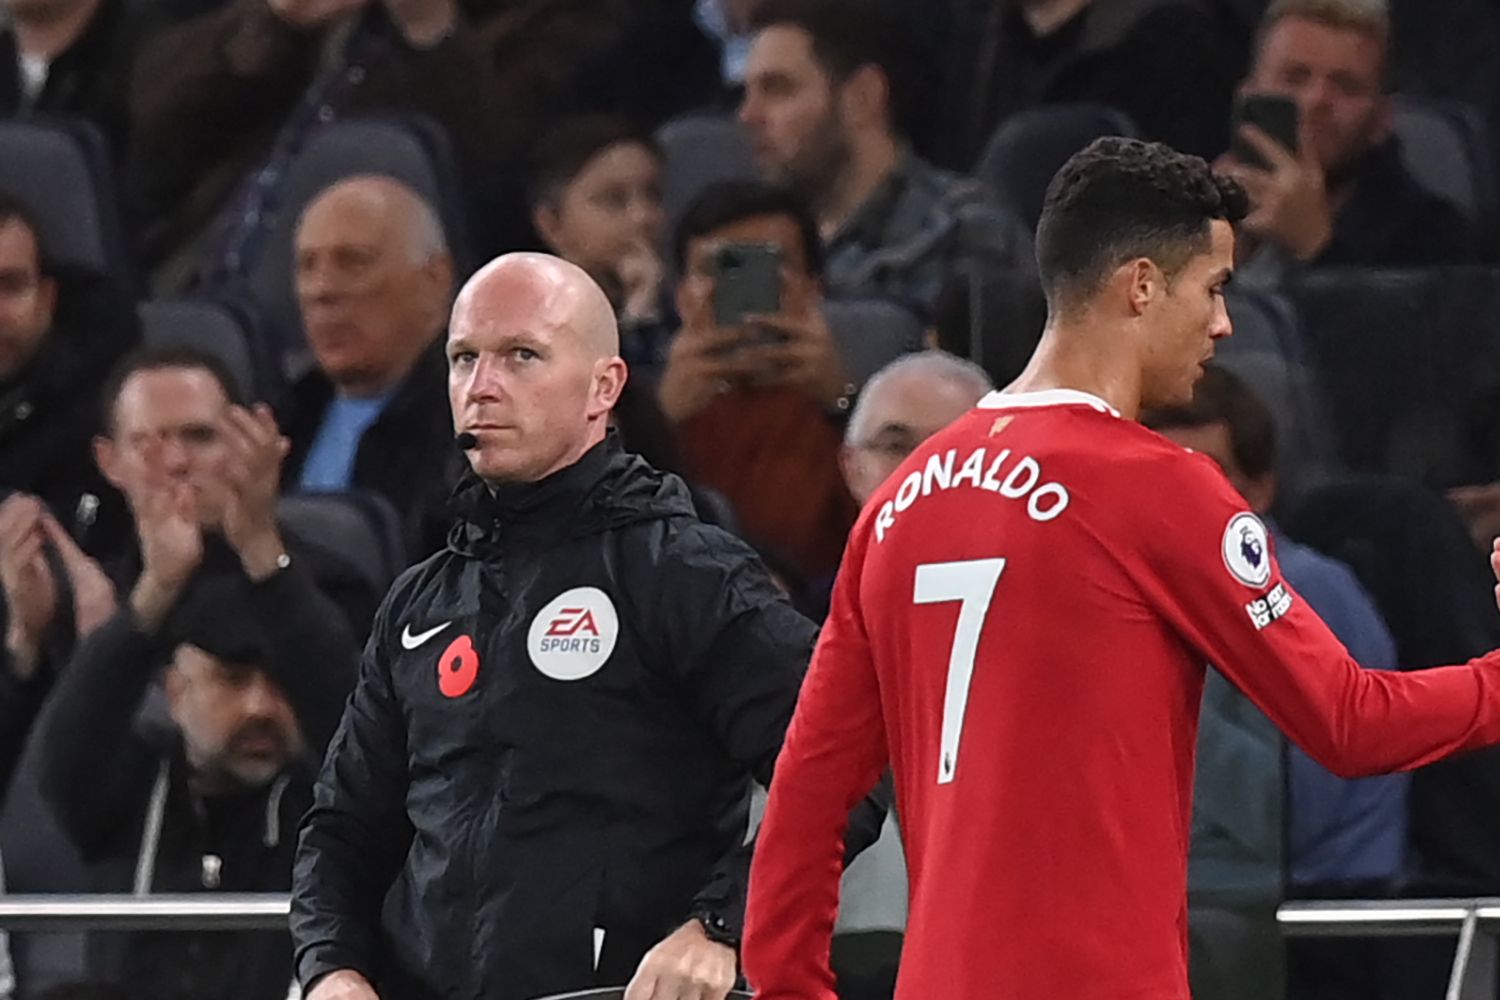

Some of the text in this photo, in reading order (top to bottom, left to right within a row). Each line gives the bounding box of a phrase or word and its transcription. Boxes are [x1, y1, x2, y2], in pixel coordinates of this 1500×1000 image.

[874, 447, 1069, 544] RONALDO
[540, 638, 601, 653] SPORTS
[544, 607, 600, 636] EA
[913, 557, 1006, 785] 7
